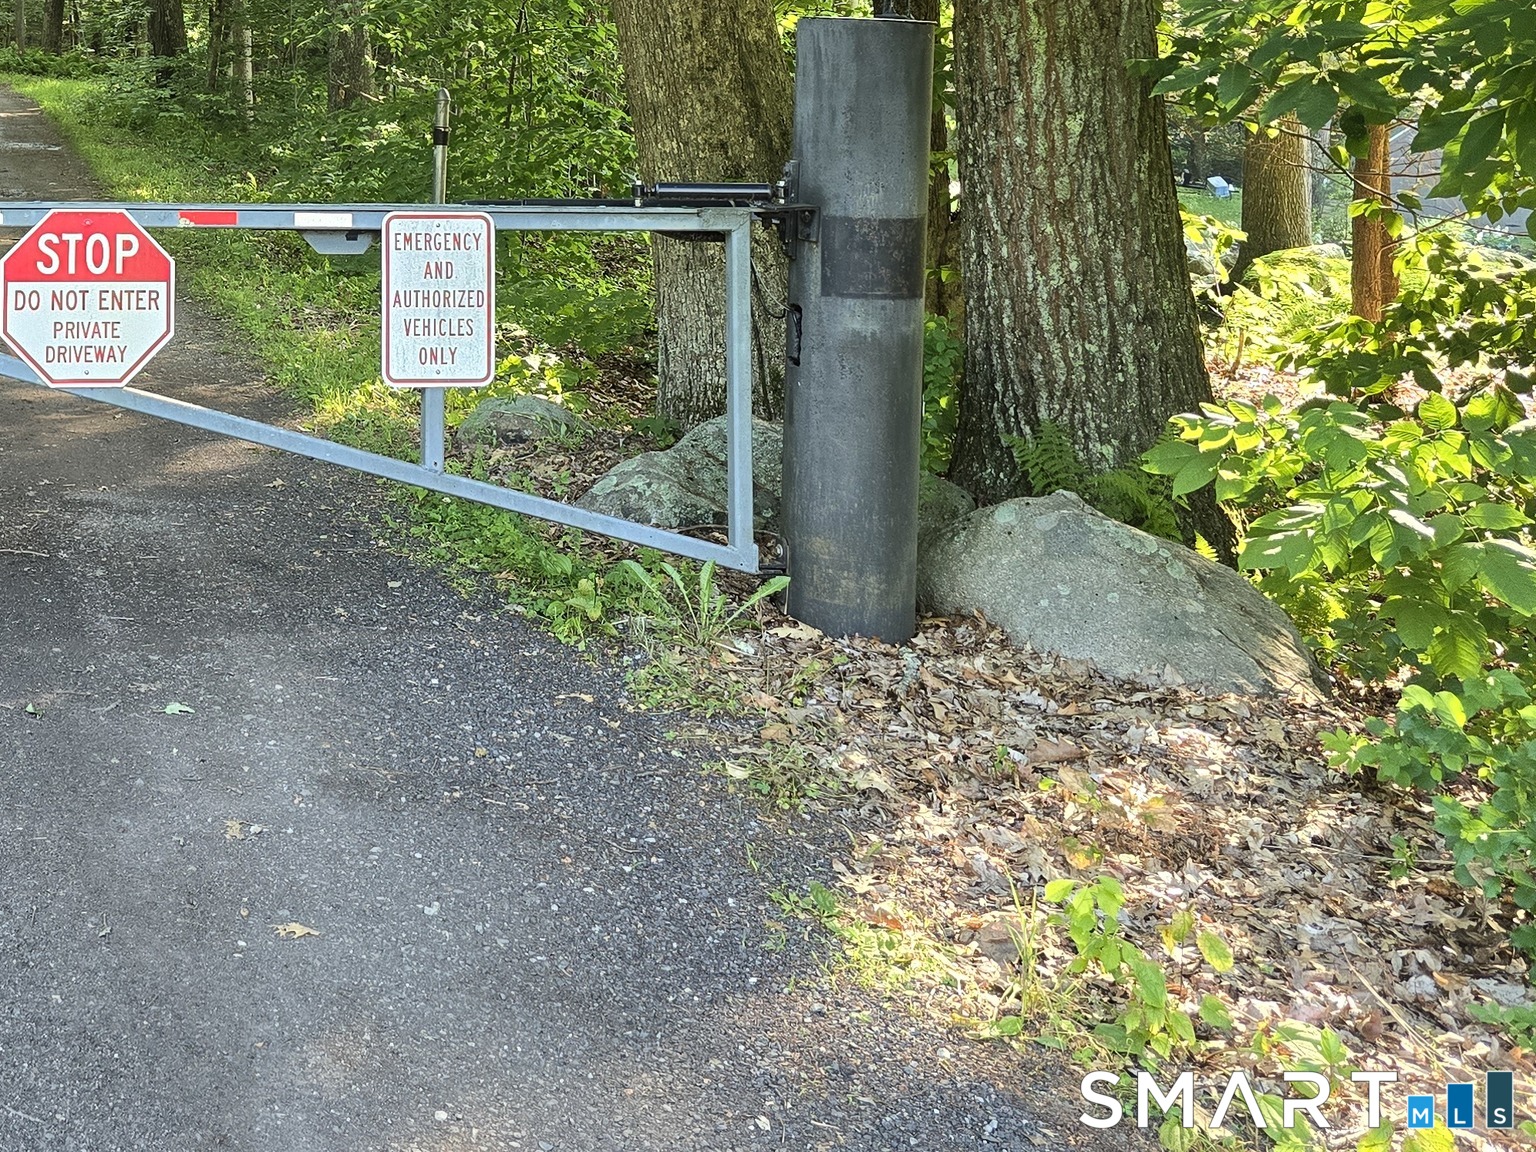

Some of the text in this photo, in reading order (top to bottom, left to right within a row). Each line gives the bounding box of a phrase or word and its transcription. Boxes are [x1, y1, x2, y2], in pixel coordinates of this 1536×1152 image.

[394, 232, 482, 251] EMERGENCY
[36, 233, 140, 275] STOP
[423, 261, 454, 280] AND
[14, 289, 160, 311] DO NOT ENTER
[392, 289, 485, 308] AUTHORIZED
[53, 321, 121, 339] PRIVATE
[403, 318, 474, 336] VEHICLES
[45, 345, 128, 363] DRIVEWAY
[418, 346, 458, 365] ONLY
